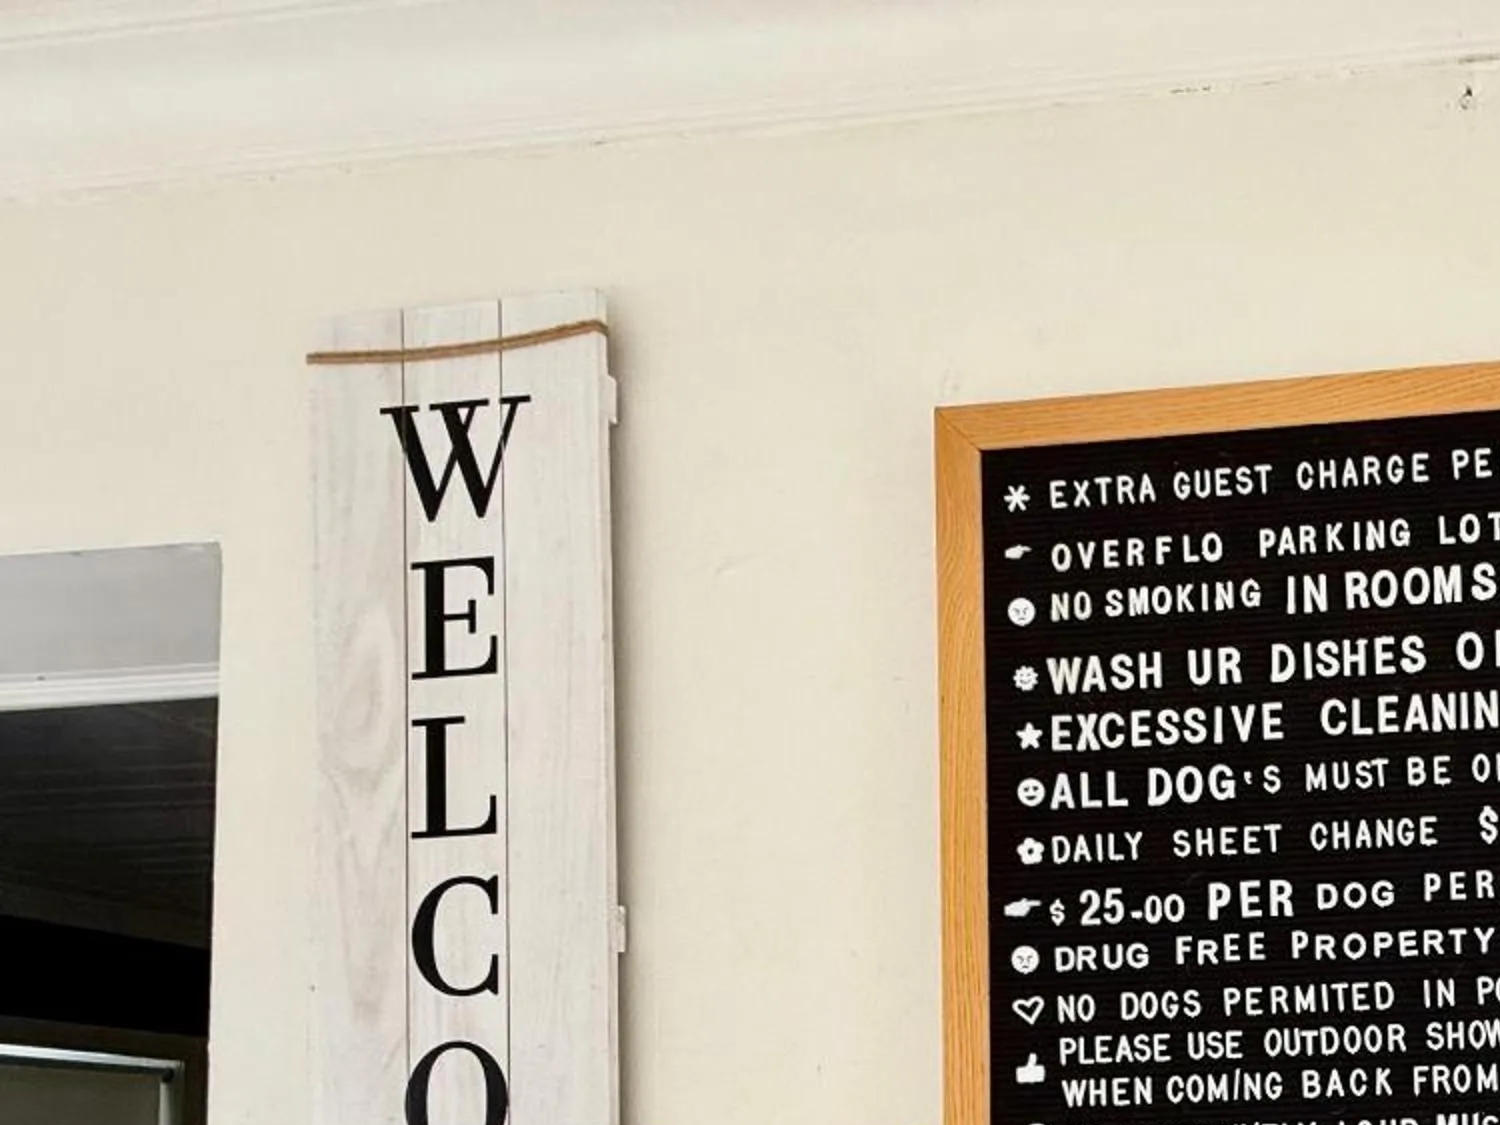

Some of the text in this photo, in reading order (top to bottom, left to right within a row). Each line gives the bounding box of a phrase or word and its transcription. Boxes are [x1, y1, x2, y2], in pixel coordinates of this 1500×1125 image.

[1049, 473, 1156, 509] EXTRA
[1173, 464, 1273, 501] GUEST
[1296, 452, 1430, 491] CHARGE
[1051, 532, 1223, 572] OVERFLO
[1259, 517, 1411, 558] PARKING
[1050, 591, 1092, 622] NO
[1104, 578, 1261, 617] SMOKING
[1286, 573, 1328, 615] IN
[1344, 562, 1497, 610] ROOMS
[1046, 651, 1163, 695] WASH
[1187, 646, 1243, 686] UR
[1270, 635, 1427, 683] DISHES
[1051, 701, 1284, 752] EXCESSIVE
[1051, 831, 1143, 865] DAILY
[1173, 823, 1282, 858] SHEET
[1309, 815, 1438, 851] CHANGE
[1208, 879, 1294, 921] PER
[1316, 879, 1395, 911] DOG
[1423, 869, 1495, 902] PER
[1054, 942, 1149, 973] DRUG
[1175, 931, 1266, 966] FREE
[1291, 927, 1495, 961] PROPERTY
[1061, 1076, 1153, 1108] WHEN
[1301, 1067, 1393, 1099] BACK
[1413, 1063, 1499, 1097] FROM
